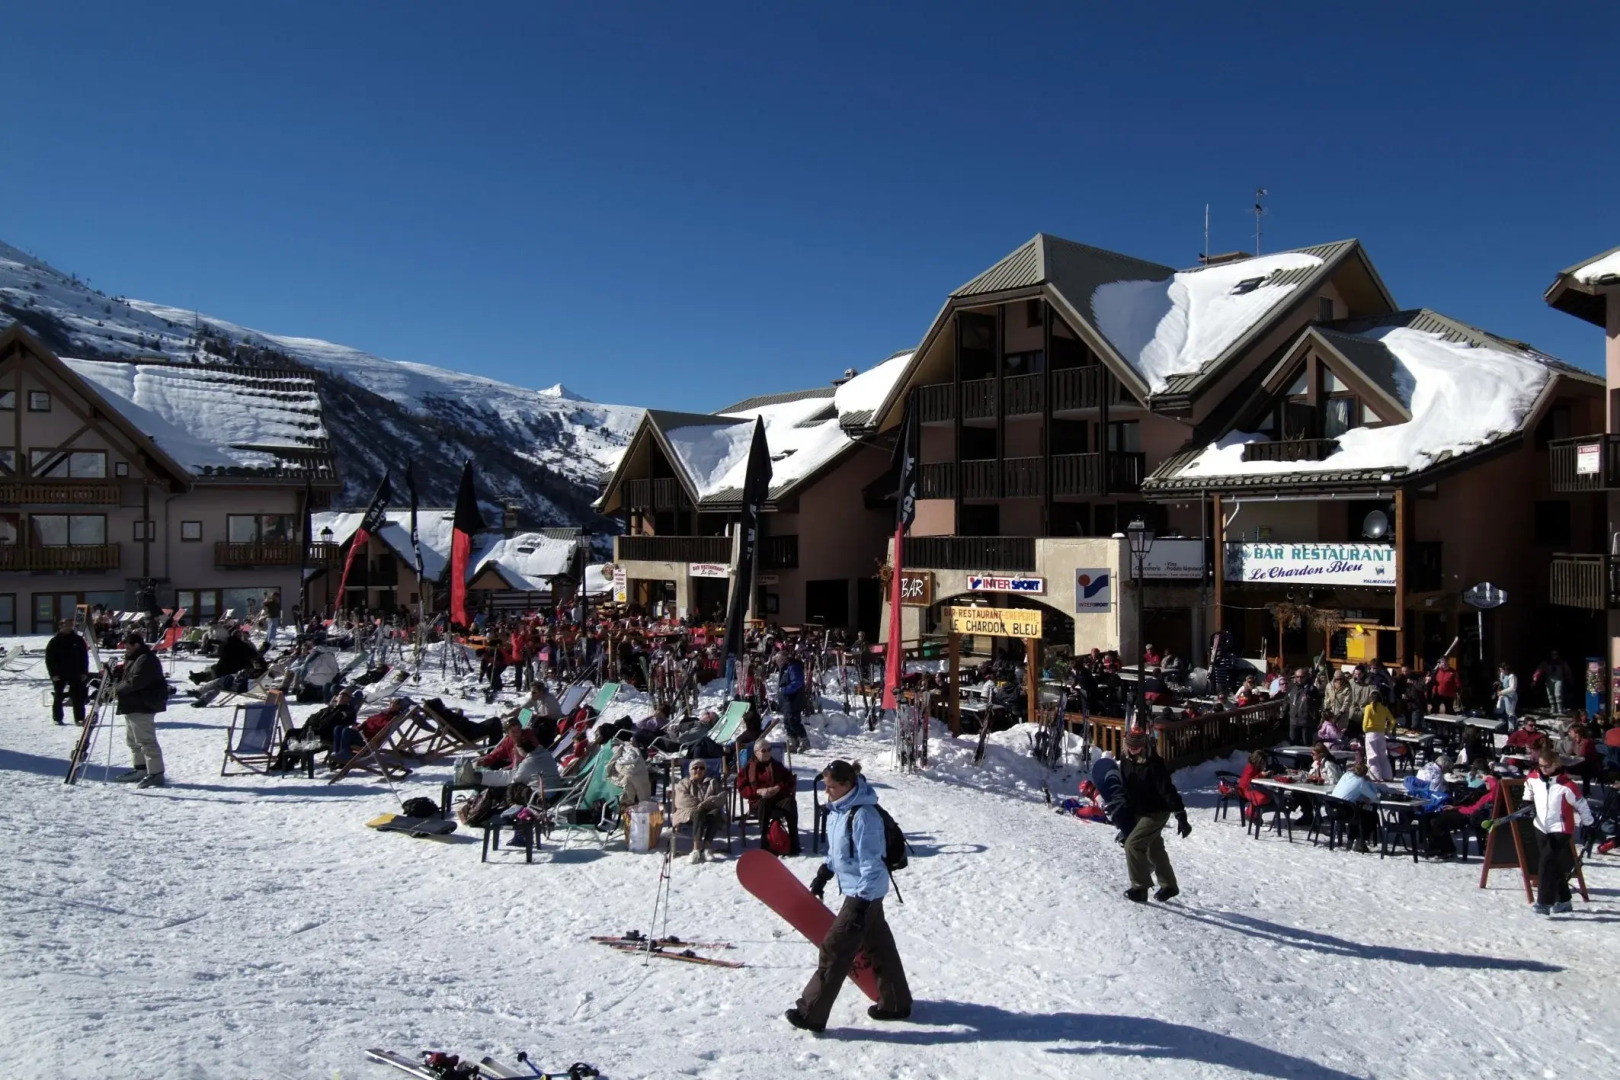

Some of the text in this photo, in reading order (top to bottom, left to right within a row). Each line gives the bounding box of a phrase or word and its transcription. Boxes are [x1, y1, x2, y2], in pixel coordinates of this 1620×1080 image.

[1254, 548, 1394, 561] BAR RESTAURANT
[1248, 561, 1363, 580] Le Chardon Bleu
[901, 578, 923, 598] BAR
[950, 620, 1038, 636] LE CHARDON BLEU
